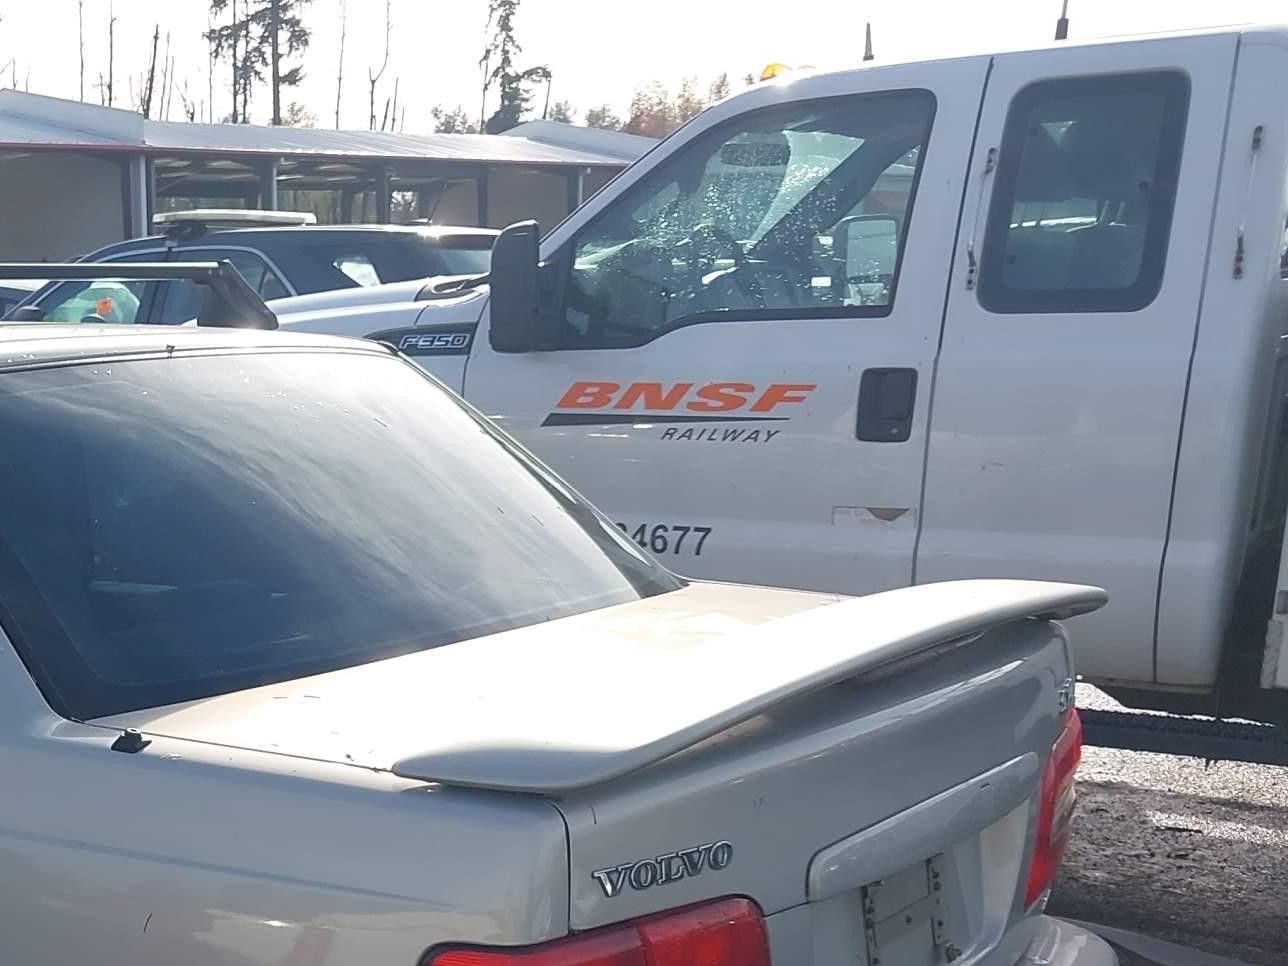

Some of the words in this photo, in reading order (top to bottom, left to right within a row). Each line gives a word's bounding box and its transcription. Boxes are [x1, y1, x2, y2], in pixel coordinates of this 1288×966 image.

[555, 381, 818, 413] BNSF
[660, 427, 780, 443] RAILWAY
[591, 839, 734, 898] VOLVO
